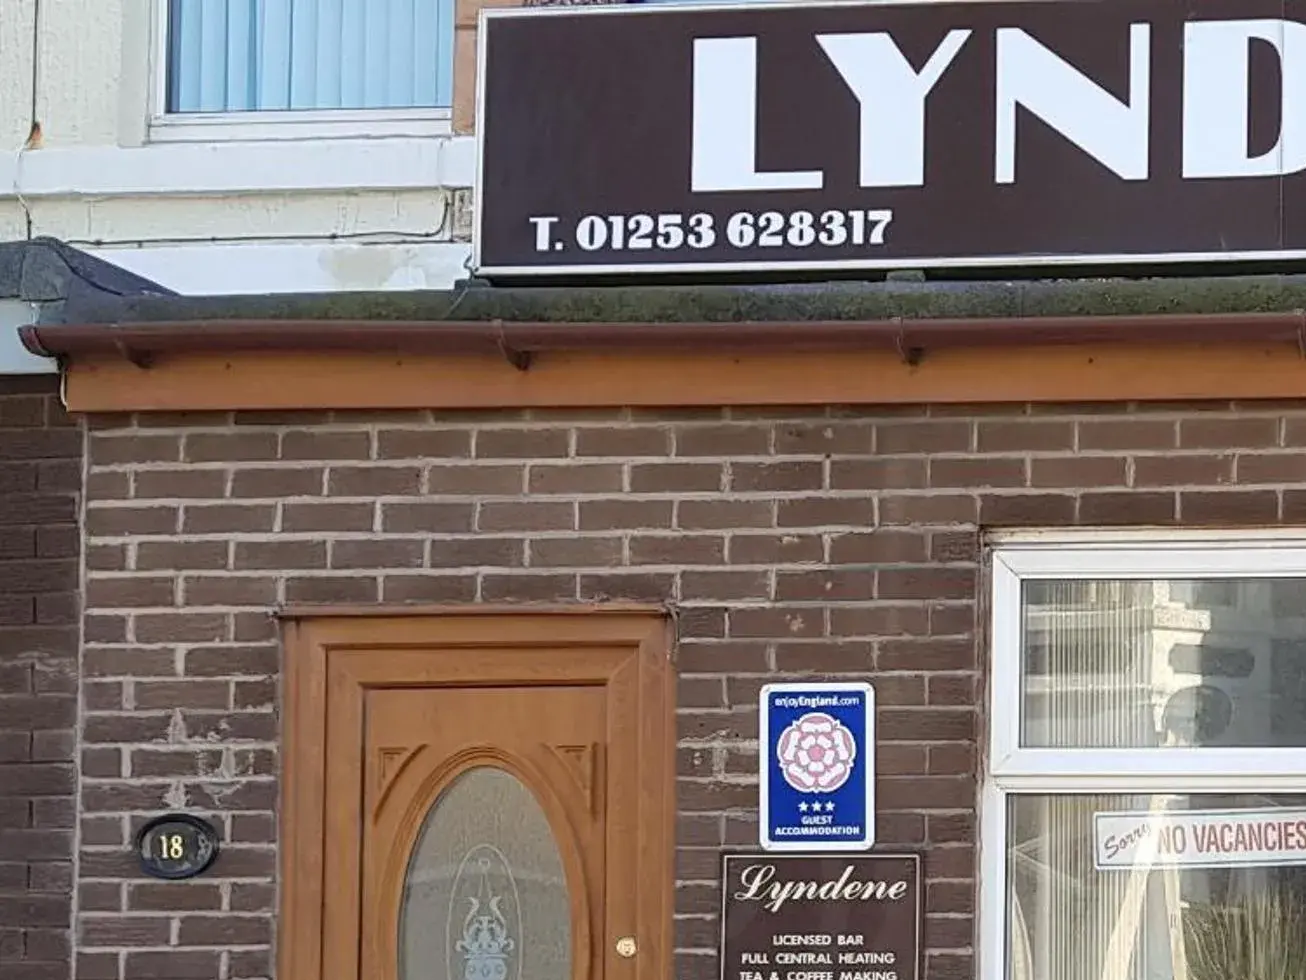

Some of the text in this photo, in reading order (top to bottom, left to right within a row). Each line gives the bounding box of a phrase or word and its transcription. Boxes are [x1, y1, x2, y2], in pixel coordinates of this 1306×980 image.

[530, 210, 892, 250] T. 01253 628317
[774, 696, 860, 708] enjoyEngland.com
[801, 815, 832, 824] GUEST
[775, 826, 859, 835] ACCOMMODATION
[1158, 824, 1187, 854] NO
[160, 835, 183, 858] 18
[734, 865, 907, 912] Lyndene
[773, 935, 863, 945] LICENSED BAR
[742, 953, 895, 964] FULL CENTRAL HEATING
